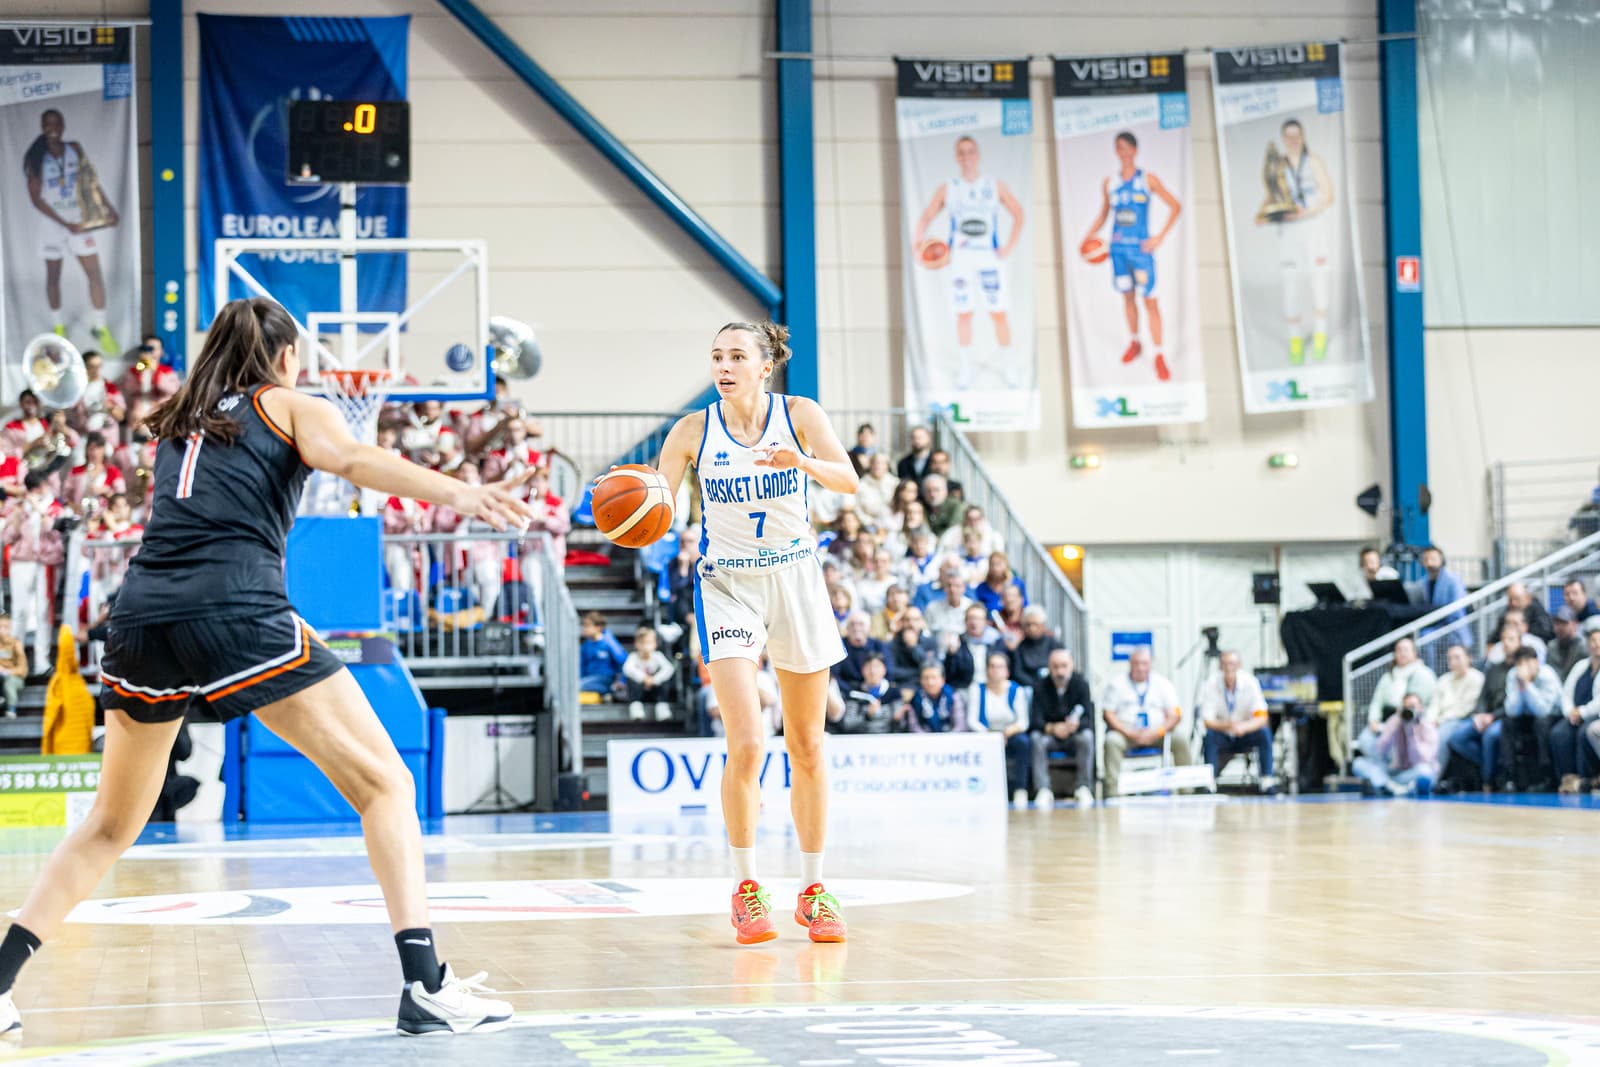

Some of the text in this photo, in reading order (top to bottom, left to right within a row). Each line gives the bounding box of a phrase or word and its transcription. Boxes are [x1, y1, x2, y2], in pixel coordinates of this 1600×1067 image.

[913, 62, 993, 83] VISIO
[1070, 58, 1149, 80] VISIO
[222, 214, 388, 237] EUROLEAUE
[704, 467, 798, 504] BASKET LANDES
[748, 511, 767, 538] 7
[717, 547, 813, 568] PARTICIPATION
[711, 626, 753, 645] picoty
[832, 750, 983, 768] LA TRUITE FUMÉE
